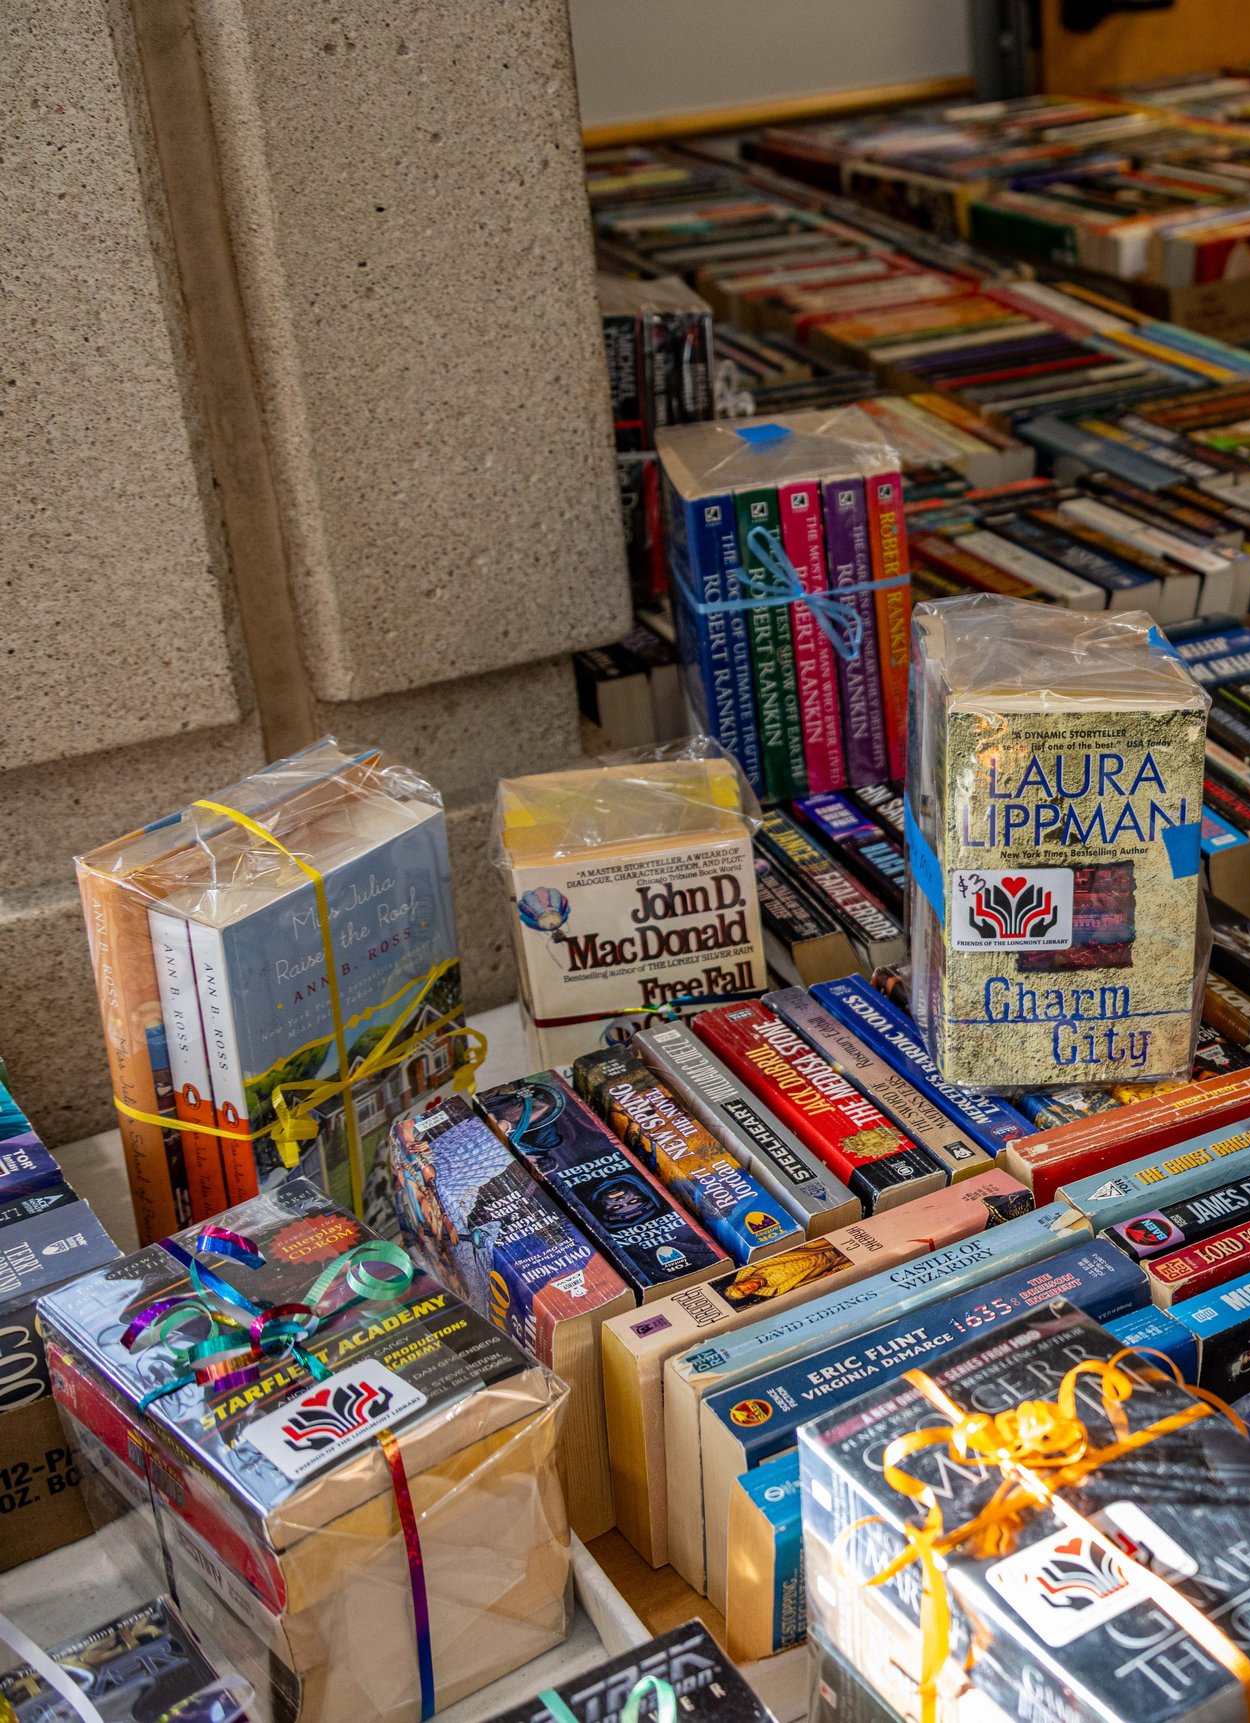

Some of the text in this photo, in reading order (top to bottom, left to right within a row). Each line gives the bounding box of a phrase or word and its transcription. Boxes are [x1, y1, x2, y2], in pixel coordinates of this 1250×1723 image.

[749, 567, 783, 748] ROBERT RANKIN
[713, 669, 738, 753] RANKIN
[800, 658, 823, 745] RANKIN
[848, 658, 868, 740] RANKIN
[787, 724, 805, 780] EARTH
[1024, 729, 1127, 739] DYNAMIC STORYTELLER
[1047, 738, 1172, 750] one of the USA Today
[989, 751, 1167, 799] LAURA
[962, 797, 1187, 847] LIPPMAN
[587, 850, 726, 877] MASTER STORYTELLER, WIZARD
[1022, 850, 1041, 858] York
[1043, 849, 1068, 858] Times
[1070, 848, 1117, 857] Bestselling
[345, 874, 396, 911] Julia
[566, 877, 612, 888] DIALOGUE,
[637, 864, 742, 887] Chicago Tribune Book World
[340, 886, 418, 948] the Roof
[631, 882, 710, 923] John
[711, 874, 746, 911] D.
[814, 872, 860, 907] FATAL
[848, 900, 899, 940] ERROR
[367, 927, 412, 961] ROSS
[564, 946, 753, 983] Bestselling author THE LONELY SILVER RAIN
[162, 942, 189, 1052] ANN ROSS
[638, 960, 756, 1008] Free Fall
[984, 976, 1131, 1023] Charm
[204, 962, 229, 1070] ANN ROSS
[842, 995, 896, 1035] VOICES
[1053, 1018, 1152, 1068] City
[745, 1043, 836, 1116] JACK DUBRUL
[752, 1017, 885, 1127] THE MEDUSA STONE
[885, 1075, 917, 1097] TEARS
[645, 1087, 681, 1119] NOVEL
[869, 1082, 935, 1133] THE SWORD OF
[928, 1072, 992, 1125] MERCEDES
[609, 1083, 694, 1161] NEW SPRING
[724, 1099, 811, 1182] STEELHEART
[557, 1151, 622, 1180] Jordan
[563, 1159, 633, 1189] Robert
[712, 1159, 758, 1203] Jordan
[1134, 1168, 1165, 1186] THE
[1162, 1148, 1215, 1176] GHOST
[688, 1167, 738, 1210] Robert
[1185, 1187, 1249, 1225] JAMES
[281, 1222, 343, 1253] Interplay
[288, 1228, 355, 1260] CD-ROM
[609, 1211, 682, 1242] REBORN
[616, 1218, 687, 1249] DRAGON
[641, 1234, 677, 1249] THE
[1142, 1219, 1168, 1241] BAEN
[3, 1241, 44, 1276] TERRY
[521, 1245, 591, 1283] OWLKNIGHT
[889, 1239, 983, 1285] CASTLE OF
[897, 1247, 996, 1292] WIZARDRY
[1191, 1236, 1244, 1265] LORD
[1019, 1273, 1075, 1299] DREESON
[1025, 1279, 1082, 1307] INCIDENT
[1028, 1273, 1053, 1287] THE
[338, 1294, 447, 1356] ACADEMY
[755, 1289, 879, 1346] DAVID EDDINGS
[383, 1319, 467, 1363] PRODUCTIONS
[807, 1327, 929, 1386] ERIC FLINT
[800, 1332, 955, 1402] VIRGINIA DeMARCE
